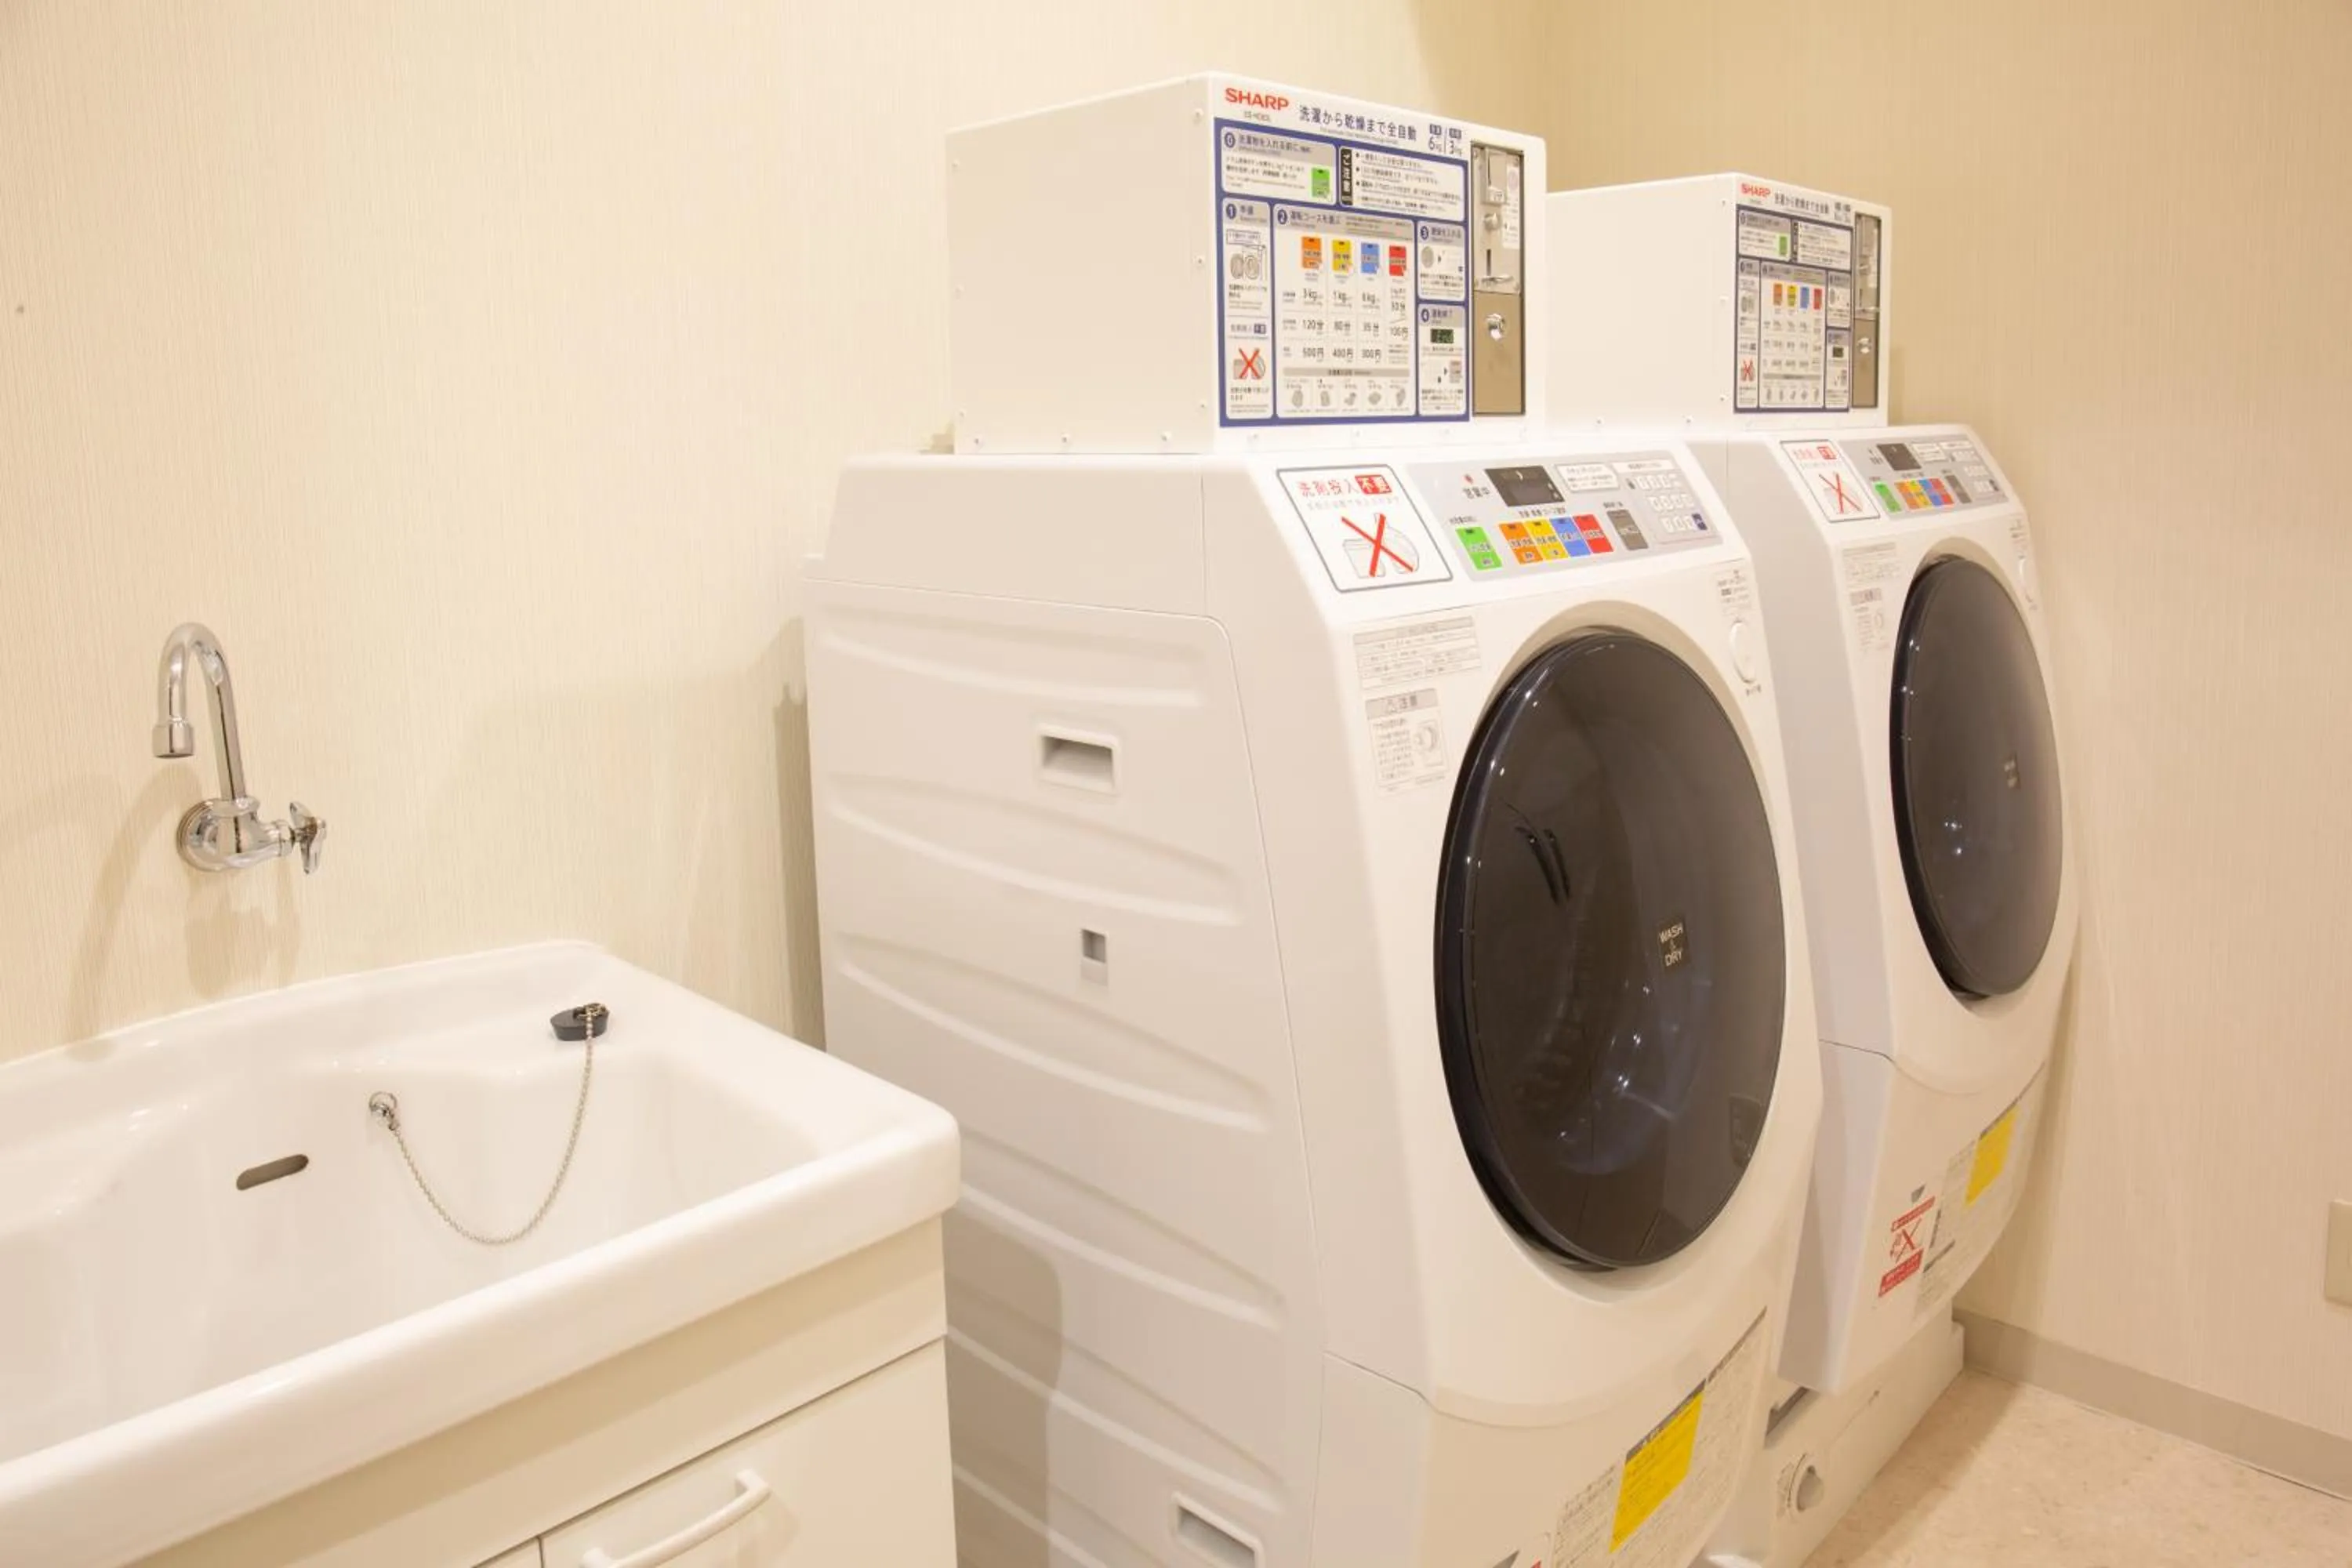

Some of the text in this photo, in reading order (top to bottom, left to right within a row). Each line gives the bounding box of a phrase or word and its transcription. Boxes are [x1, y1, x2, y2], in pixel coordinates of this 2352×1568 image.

[1225, 87, 1290, 111] SHARP
[1298, 105, 1417, 142] 洗濯から乾燥まで全自動
[1658, 923, 1683, 944] WASH
[1664, 949, 1682, 967] DRY
